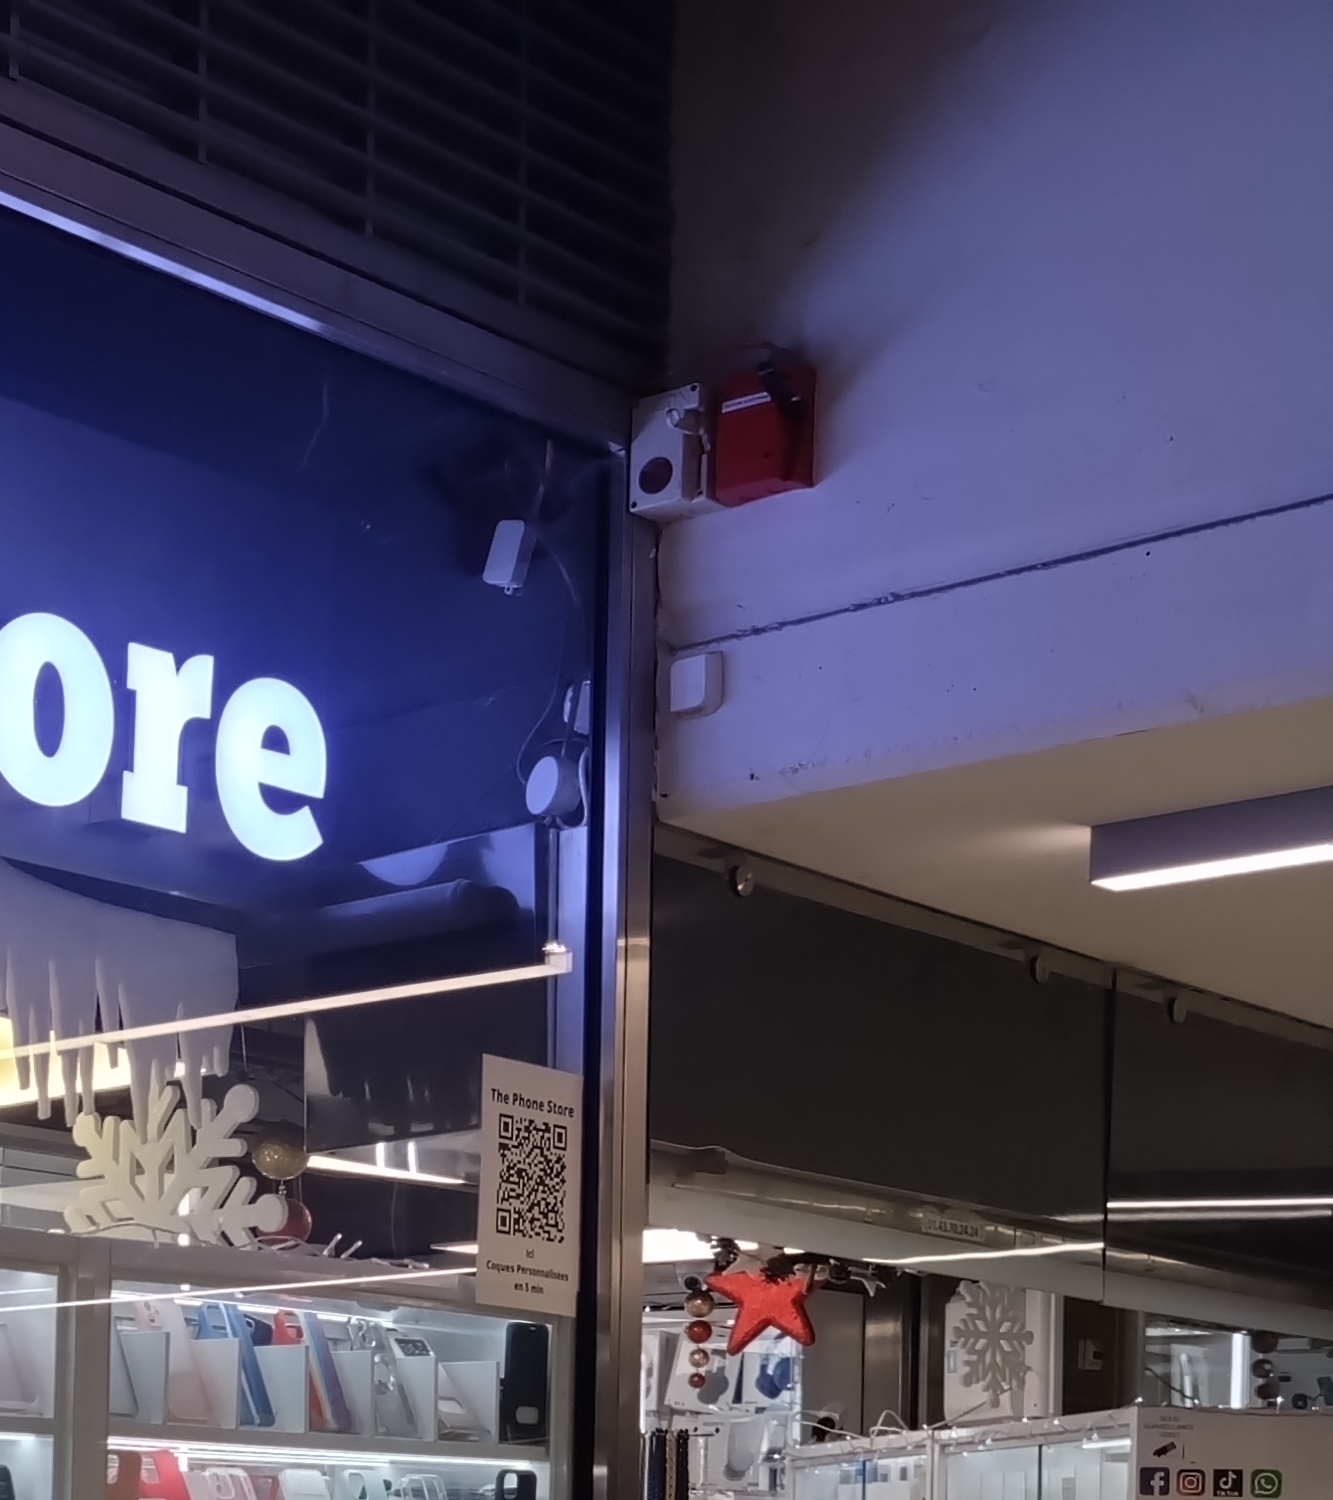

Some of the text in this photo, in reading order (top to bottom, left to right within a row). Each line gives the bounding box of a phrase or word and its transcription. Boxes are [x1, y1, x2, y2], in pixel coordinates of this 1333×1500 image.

[491, 1088, 574, 1118] The Phone Store
[486, 1259, 514, 1274] Coques
[514, 1282, 524, 1291] en
[530, 1284, 544, 1294] min
